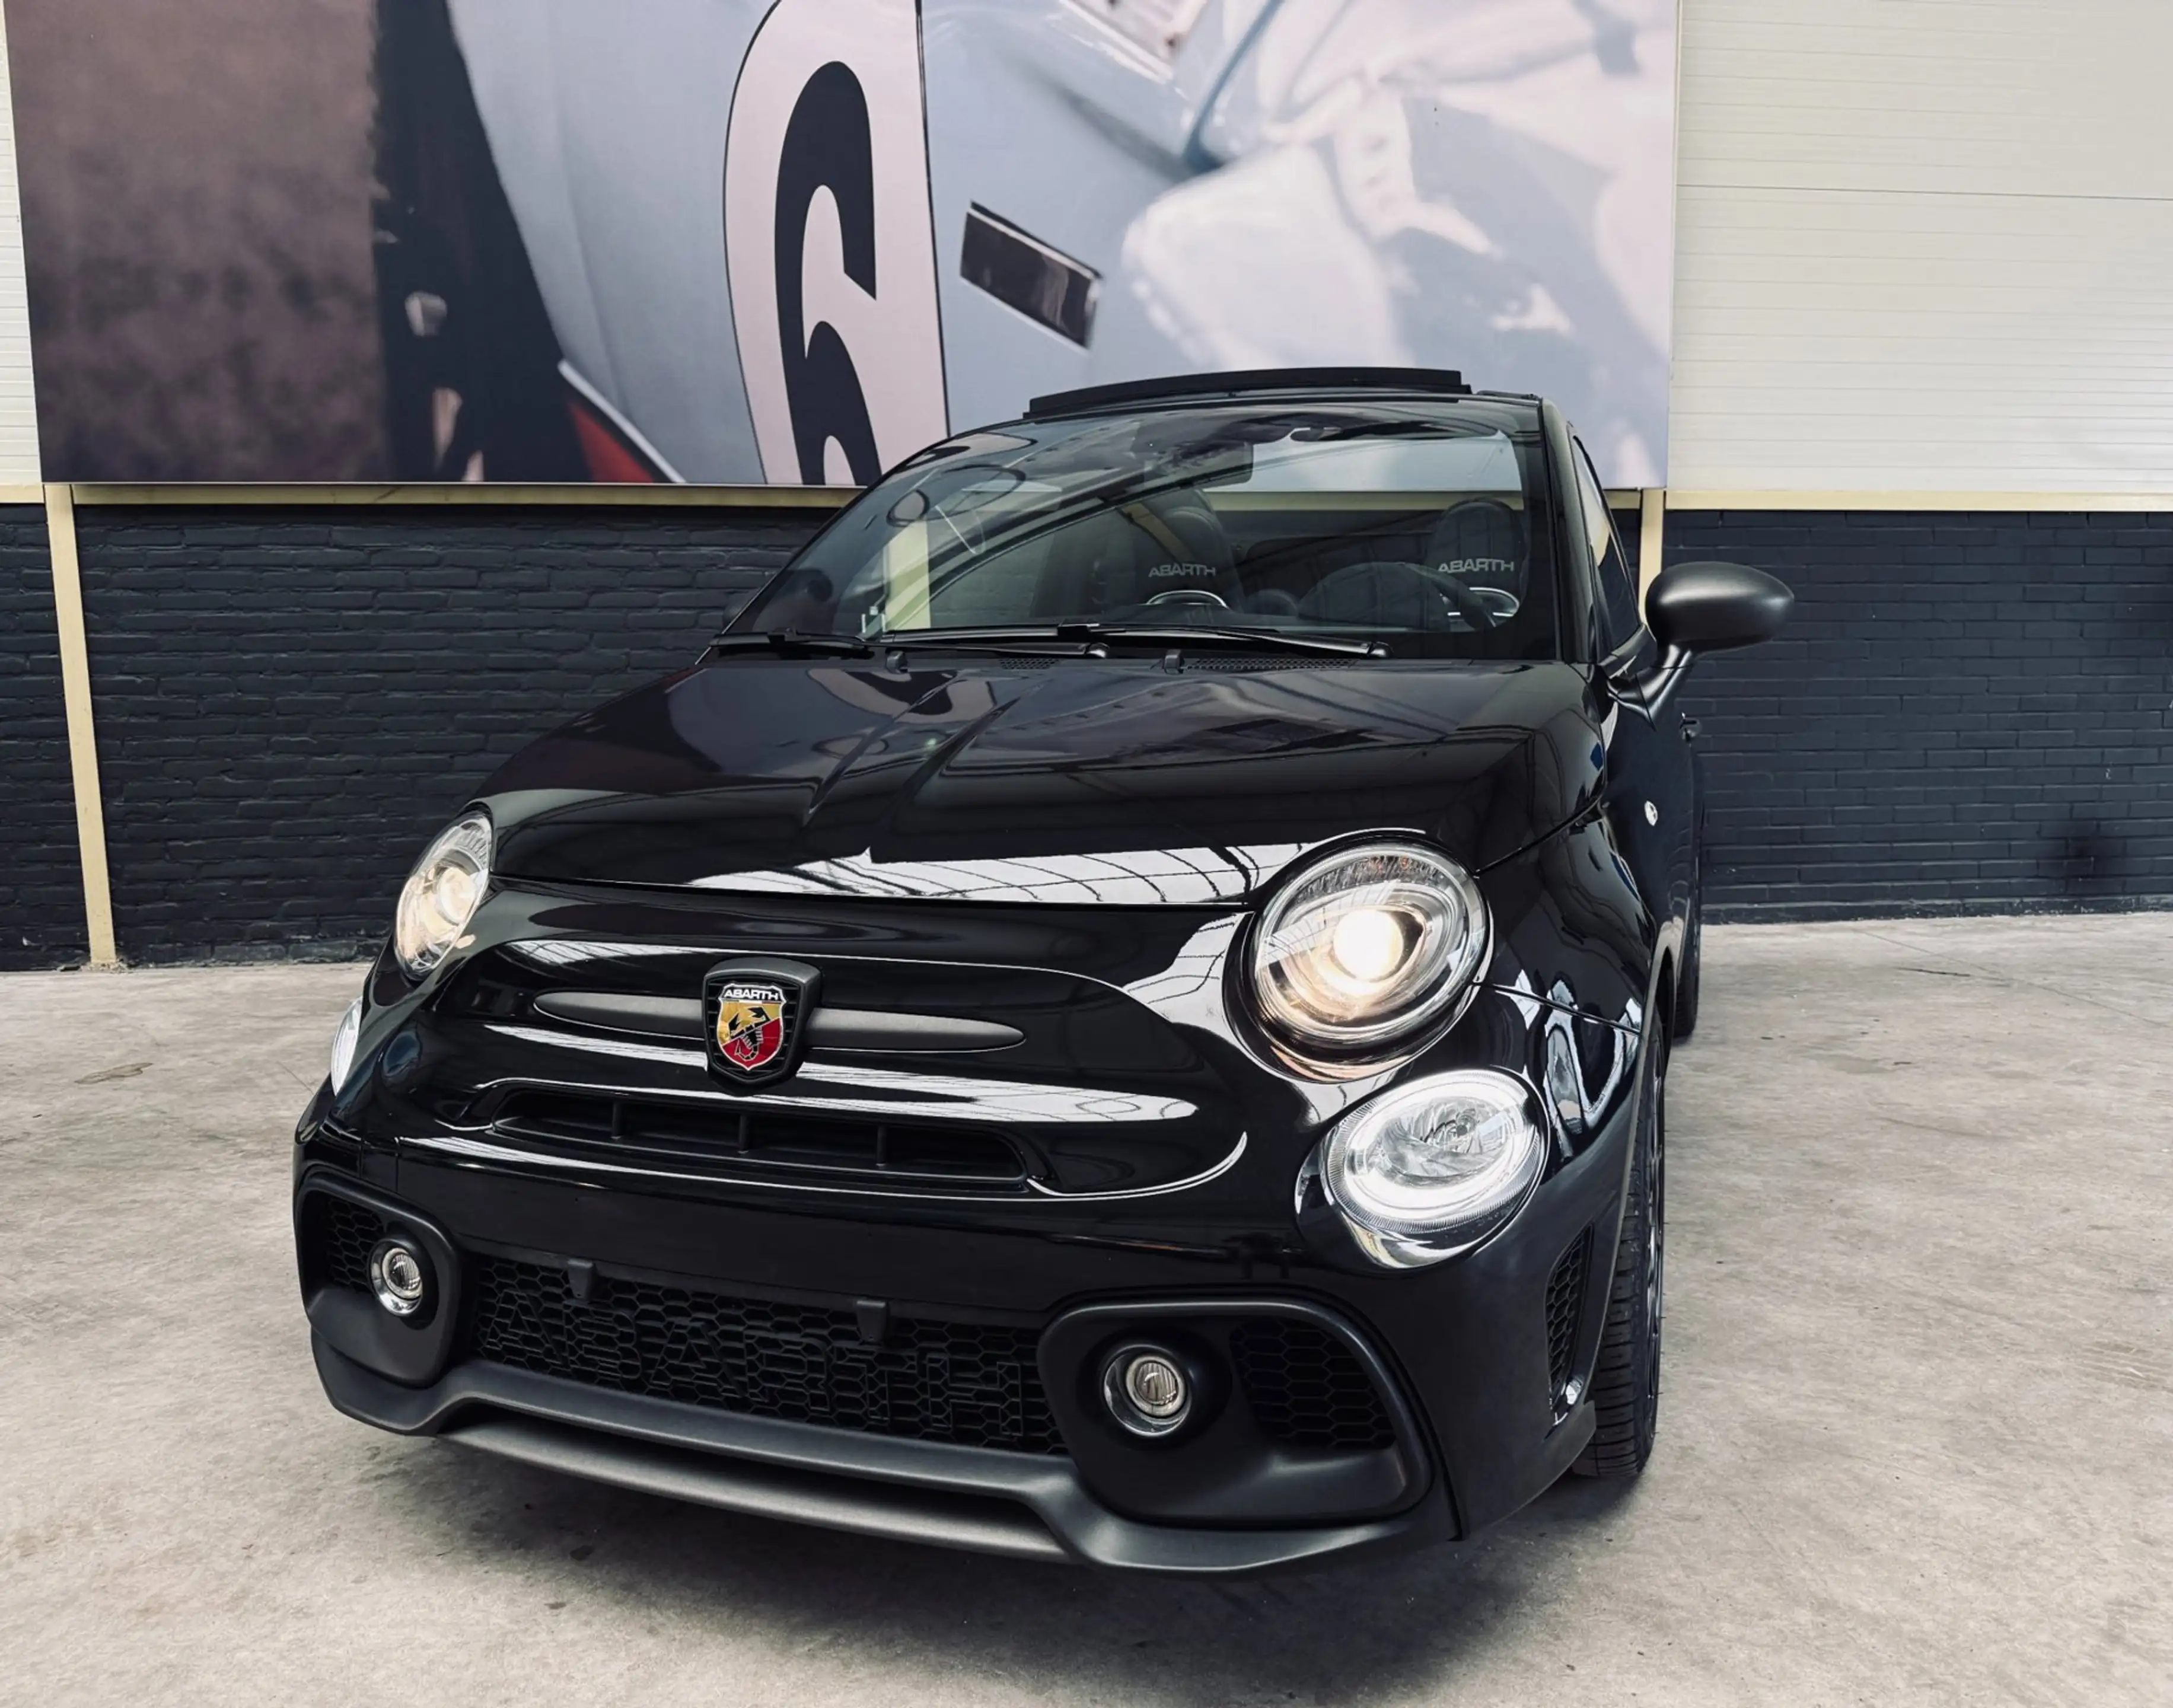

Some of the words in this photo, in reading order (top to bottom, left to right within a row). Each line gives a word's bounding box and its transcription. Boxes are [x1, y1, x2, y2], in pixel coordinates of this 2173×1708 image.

[1148, 562, 1216, 577] ABARTH
[1438, 558, 1514, 573] ABARTH
[724, 989, 778, 1000] ABARTH
